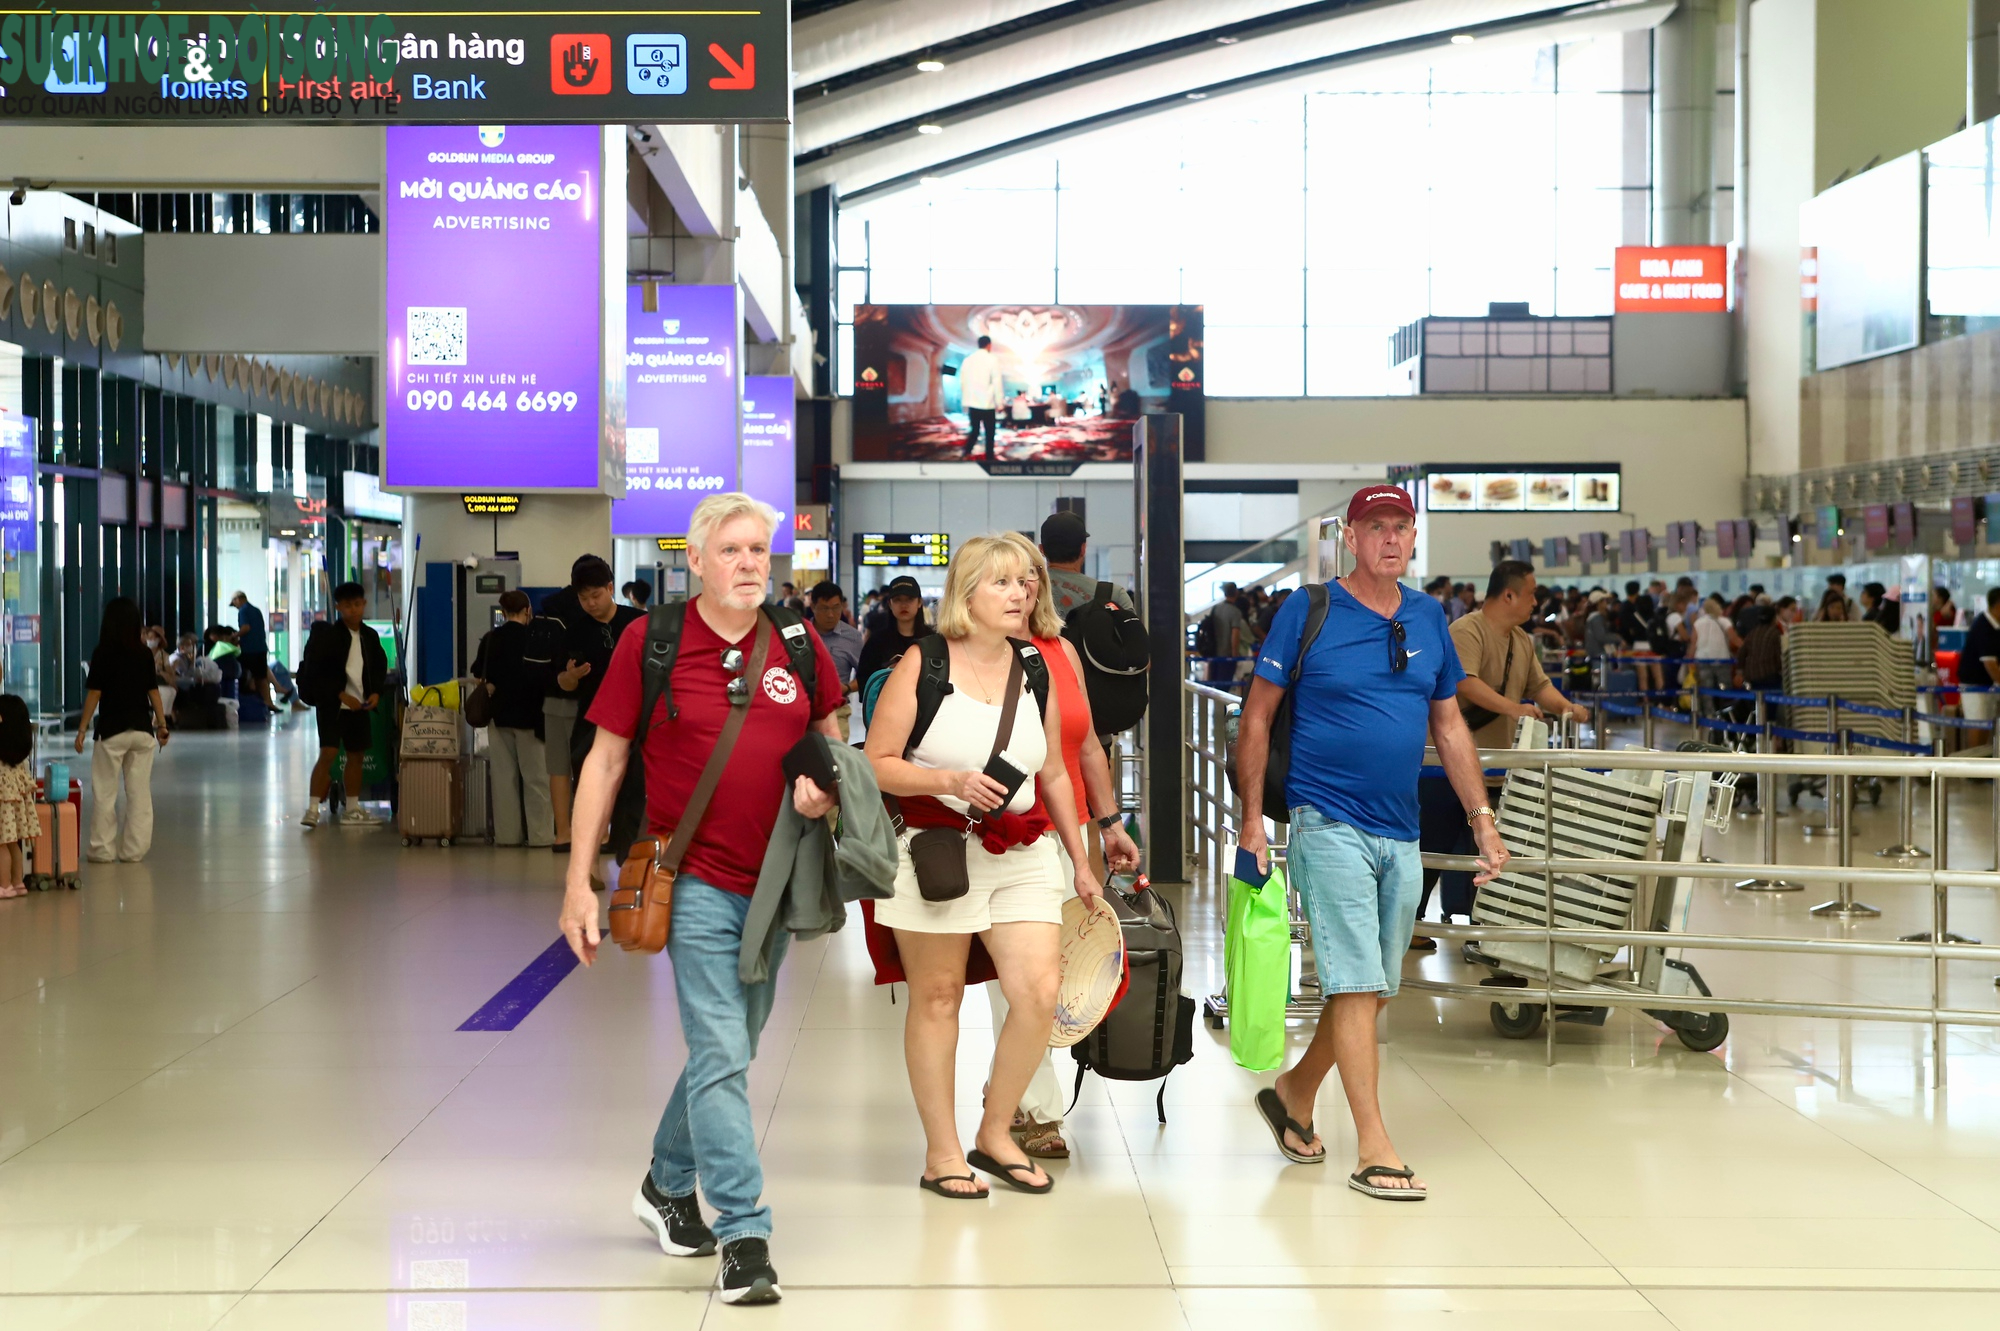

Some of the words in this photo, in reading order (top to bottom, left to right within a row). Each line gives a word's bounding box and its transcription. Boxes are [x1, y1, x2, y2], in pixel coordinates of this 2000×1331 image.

[448, 32, 525, 65] hàng
[412, 73, 487, 100] Bank
[428, 152, 478, 163] GOLDSUN
[481, 153, 514, 164] MEDIA
[516, 154, 555, 165] GROUP
[400, 177, 442, 198] MỜI
[448, 176, 528, 202] QUẢNG
[533, 179, 582, 200] CÁO
[433, 215, 550, 230] ADVERTISING
[1691, 283, 1724, 299] FOOD
[646, 351, 694, 367] QUẢNG
[696, 352, 725, 366] CÁO
[407, 373, 429, 384] CHI
[434, 371, 457, 384] TIẾT
[463, 374, 484, 384] XIN
[490, 374, 516, 385] LIÊN
[637, 374, 707, 383] ADVERTISING
[407, 390, 453, 411] 090
[461, 390, 508, 412] 464
[516, 391, 578, 412] 6699
[655, 476, 683, 490] 464
[686, 476, 724, 490] 6699
